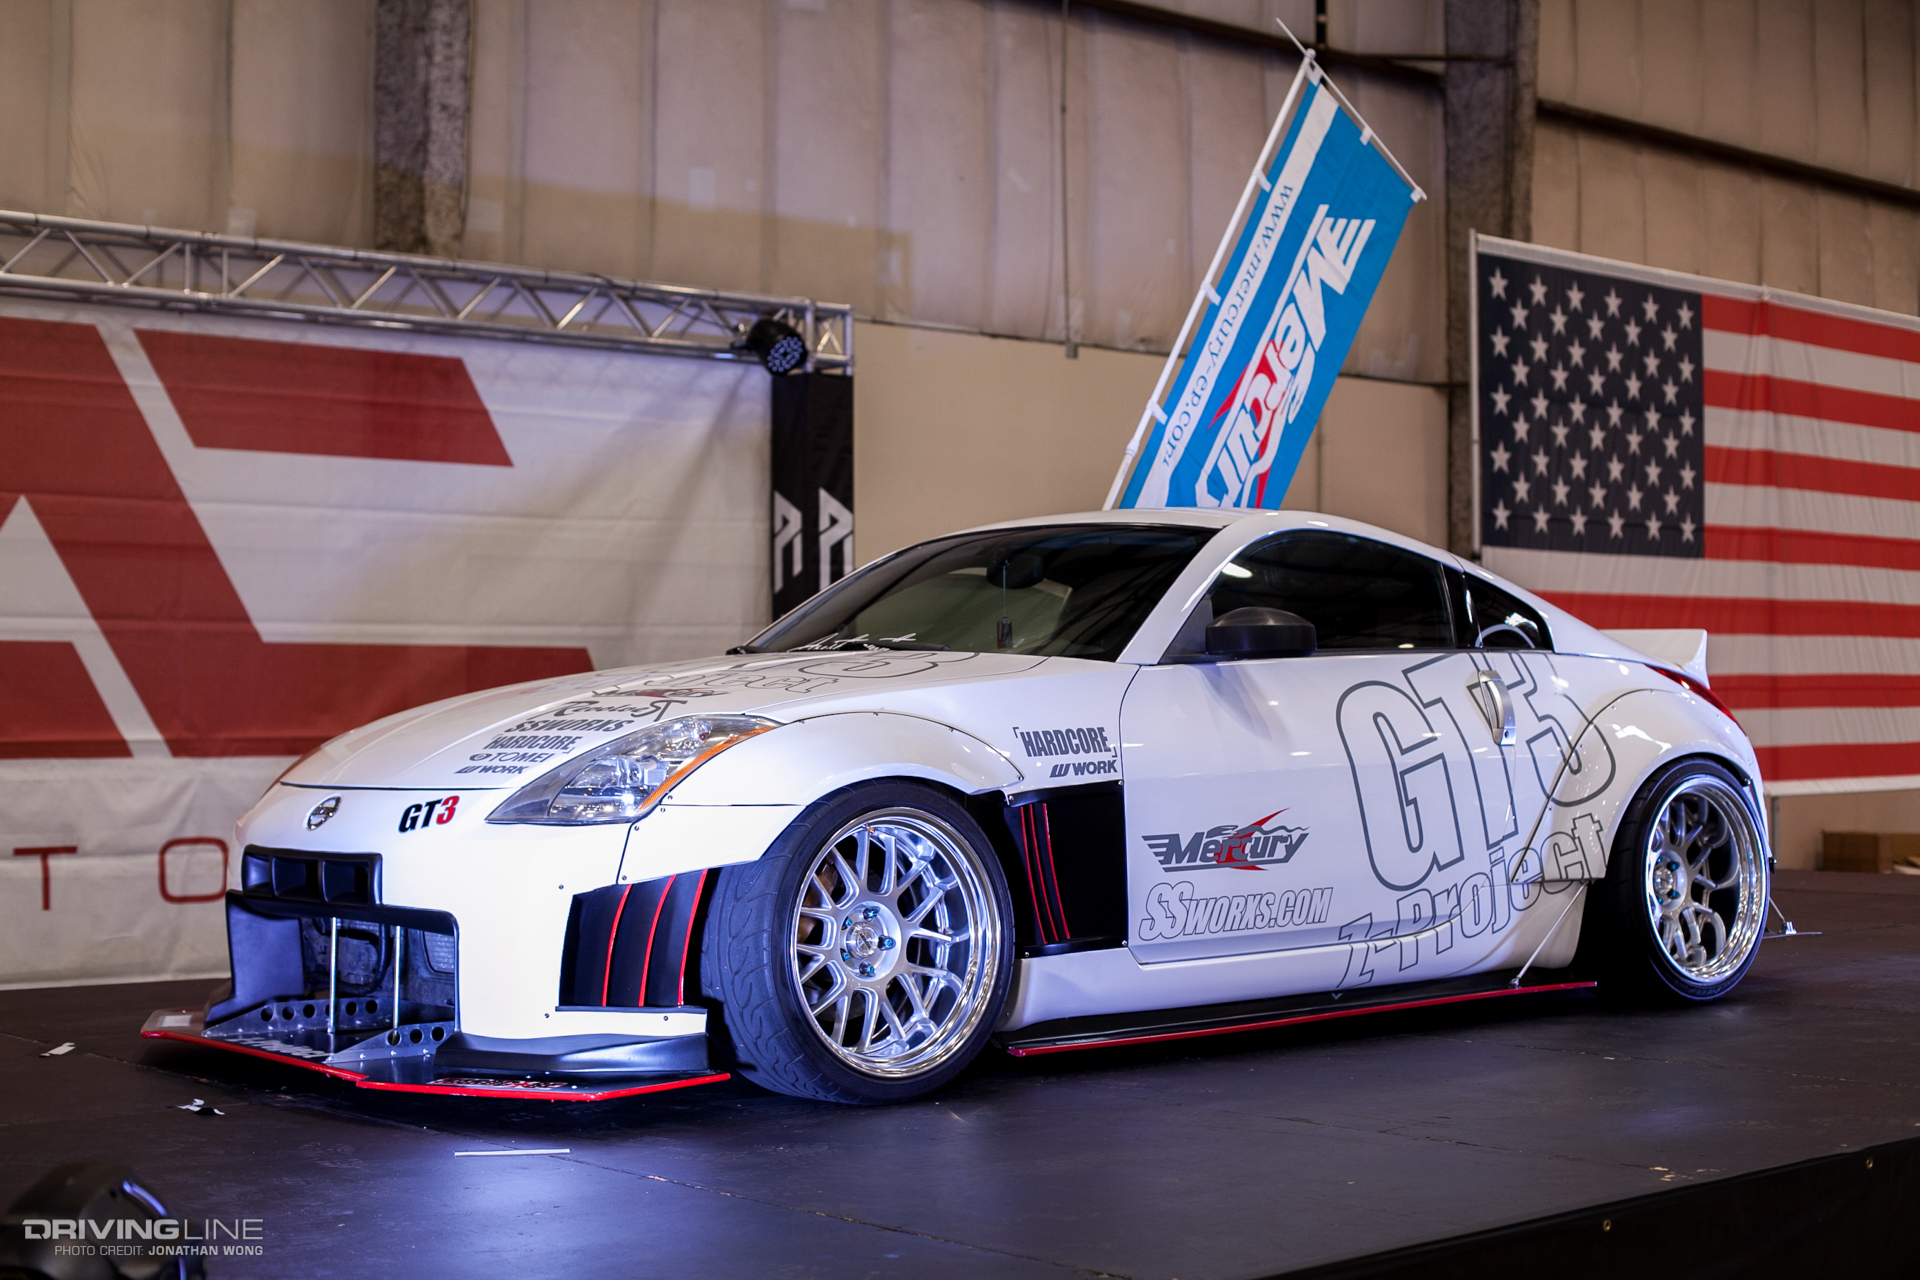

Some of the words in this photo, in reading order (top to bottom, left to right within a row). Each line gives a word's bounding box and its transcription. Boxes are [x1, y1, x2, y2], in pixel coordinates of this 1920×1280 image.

[1162, 184, 1294, 468] www.mercury-ep.com
[483, 735, 583, 751] HARDCORE
[1019, 727, 1112, 757] HARDCORE
[489, 752, 553, 763] TOMEI
[1072, 759, 1118, 776] WORK
[480, 765, 530, 775] WORK
[398, 795, 460, 834] GT3
[1141, 825, 1310, 873] Mercury
